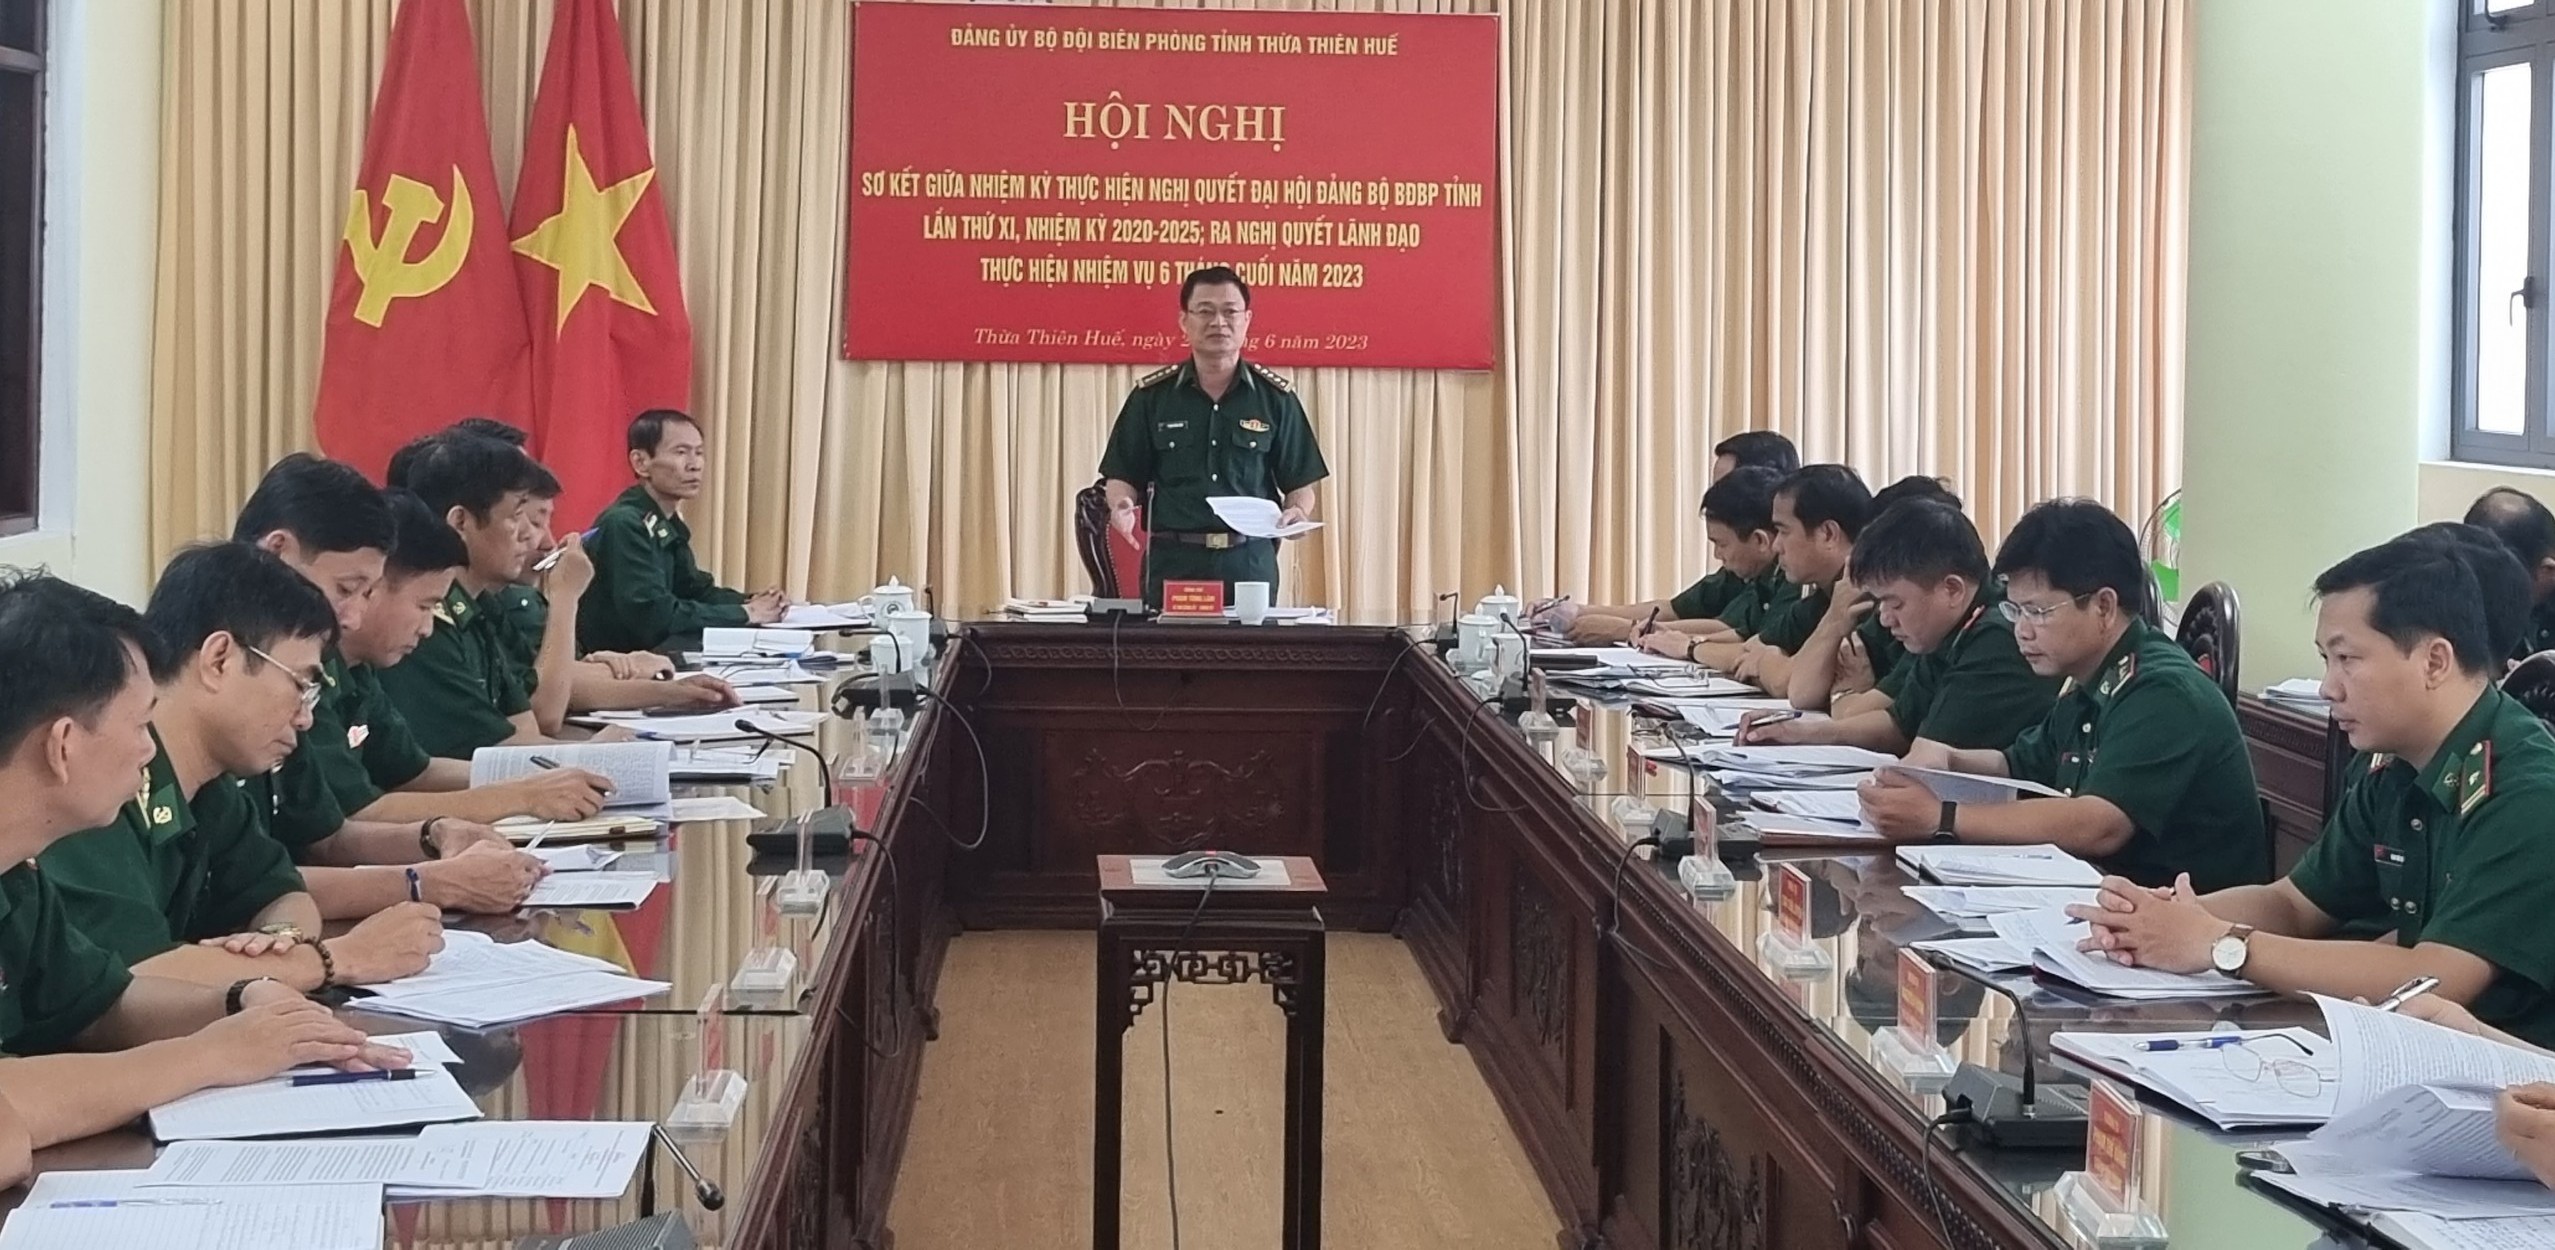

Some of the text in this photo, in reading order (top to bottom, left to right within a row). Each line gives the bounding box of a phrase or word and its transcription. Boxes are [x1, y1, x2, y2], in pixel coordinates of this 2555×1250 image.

[951, 23, 1398, 55] ĐẢNG ỦY BỘ ĐỘI BIÊN PHÒNG TỈNH THỪA THIÊN HUẾ
[1063, 91, 1285, 151] HỘI NGHỊ
[862, 170, 885, 196] SƠ
[889, 165, 920, 197] KẾT
[925, 169, 965, 197] GIỮA
[969, 170, 1025, 204] NHIỆM
[1056, 174, 1099, 205] THỰC
[1104, 172, 1143, 206] HIỆN
[1149, 177, 1189, 207] NGHỊ
[1194, 172, 1246, 205] QUYẾT
[1250, 180, 1279, 209] ĐẠI
[1283, 175, 1311, 209] HỘI
[1316, 173, 1362, 205] ĐẢNG
[1367, 177, 1389, 210] BỘ
[1394, 182, 1438, 206] BĐBP
[1443, 175, 1482, 207] TỈNH
[961, 211, 995, 240] THỨ
[998, 216, 1020, 243] XI,
[1025, 212, 1080, 246] NHIỆM
[1112, 219, 1204, 246] 2020-2025;
[1210, 221, 1231, 244] RA
[1236, 221, 1276, 255] NGHỊ
[1282, 215, 1333, 247] QUYẾT
[1338, 218, 1381, 246] LÃNH
[1386, 223, 1420, 252] ĐẠO
[980, 256, 1023, 287] THỰC
[1028, 254, 1068, 288] HIỆN
[1072, 255, 1128, 289] NHIỆM
[1133, 260, 1154, 289] VỤ
[1160, 261, 1170, 284] 6
[1234, 255, 1273, 287] CUỐI
[1279, 259, 1318, 287] NĂM
[1322, 264, 1363, 287] 2023
[1028, 329, 1077, 345] Thiên
[1133, 333, 1175, 349] ngày
[1265, 335, 1275, 348] 6
[1281, 336, 1318, 348] năm
[1325, 335, 1368, 349] 2023
